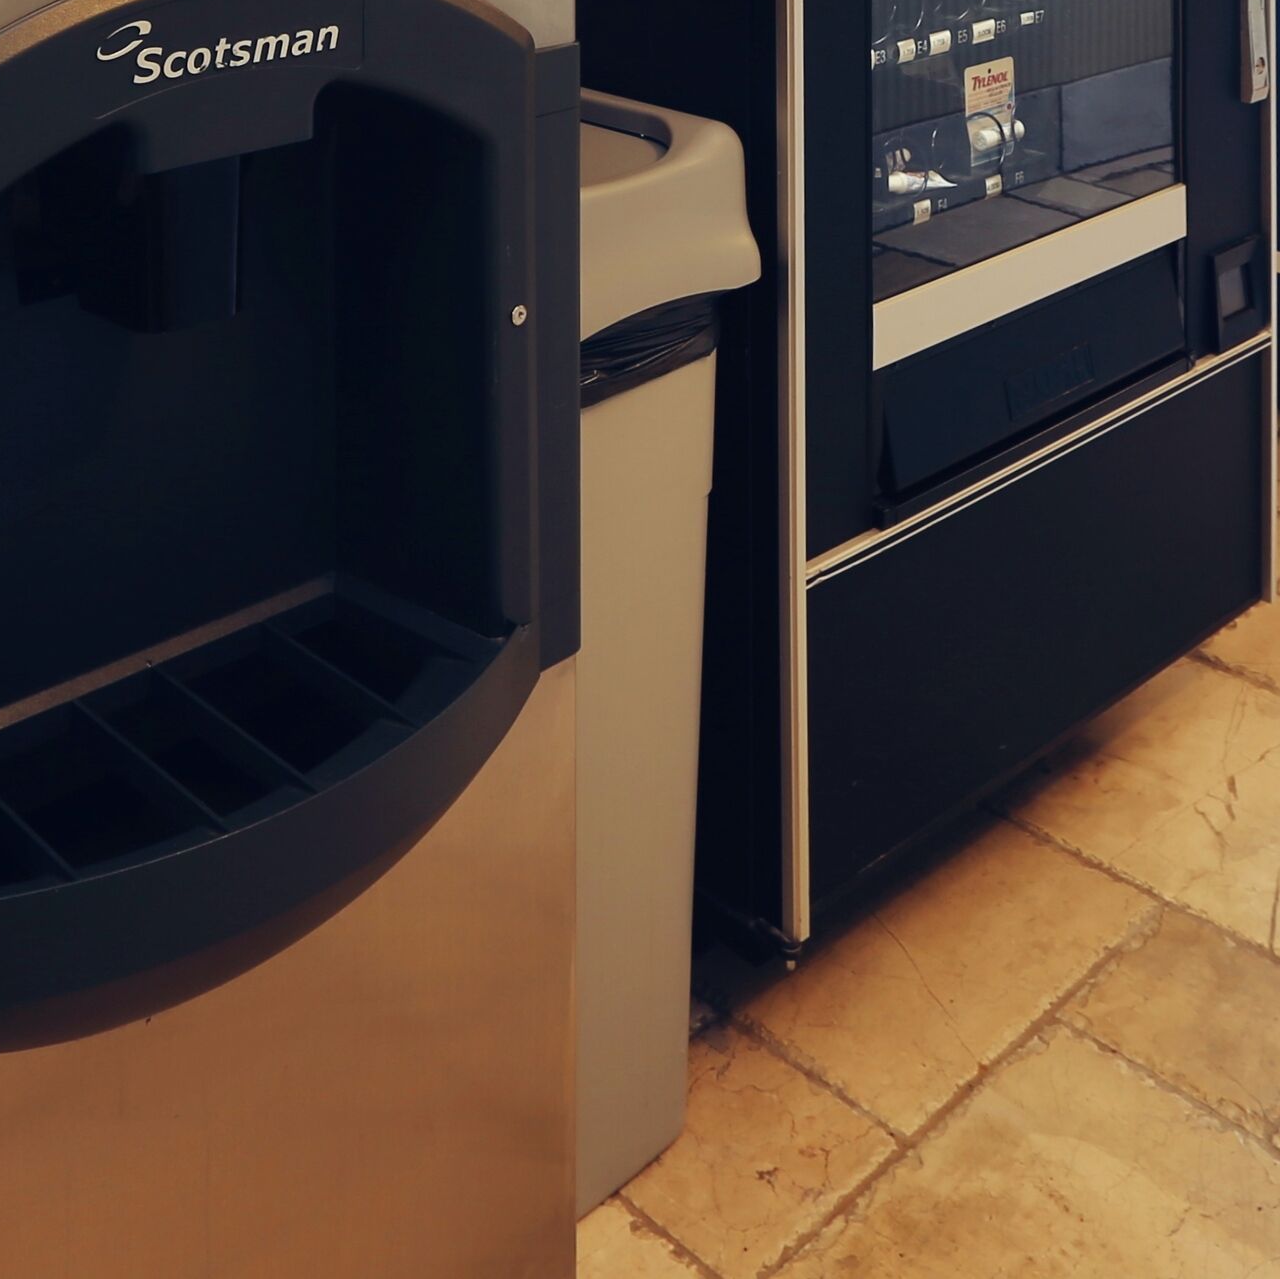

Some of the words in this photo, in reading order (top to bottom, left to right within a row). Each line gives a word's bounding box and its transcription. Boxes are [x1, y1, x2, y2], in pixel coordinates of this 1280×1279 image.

[133, 24, 340, 84] Scotsman
[876, 50, 886, 64] E3
[917, 40, 928, 54] E4
[957, 29, 968, 44] E5
[996, 19, 1007, 34] E6
[1035, 10, 1045, 24] E7
[972, 70, 1008, 91] TYLENOL
